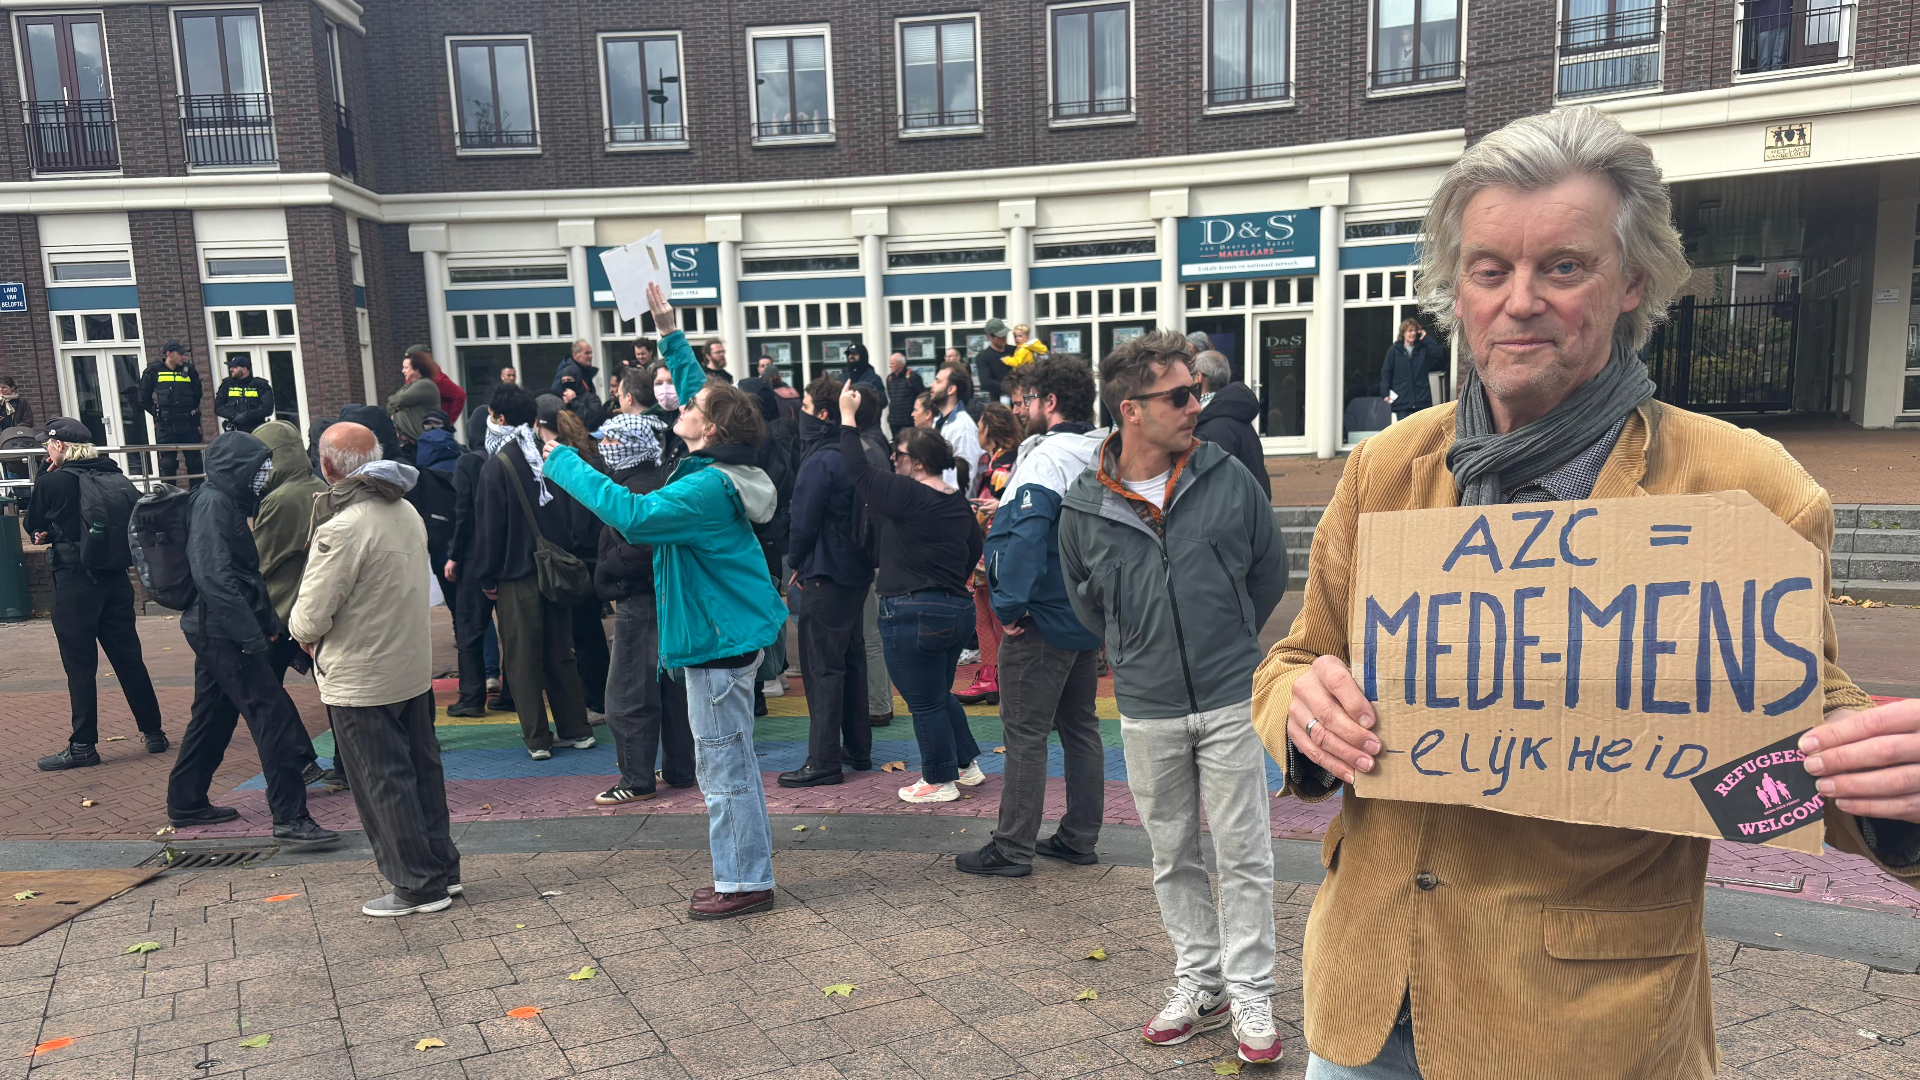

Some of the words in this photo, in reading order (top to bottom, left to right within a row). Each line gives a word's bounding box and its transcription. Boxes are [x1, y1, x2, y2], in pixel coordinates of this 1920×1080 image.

[1199, 214, 1296, 245] D&S
[1218, 247, 1275, 258] MAKELAARS
[1265, 334, 1302, 348] D&S
[1442, 508, 1598, 573] AZC
[1714, 749, 1807, 798] REFUGEES
[1738, 793, 1825, 836] WELCOM
